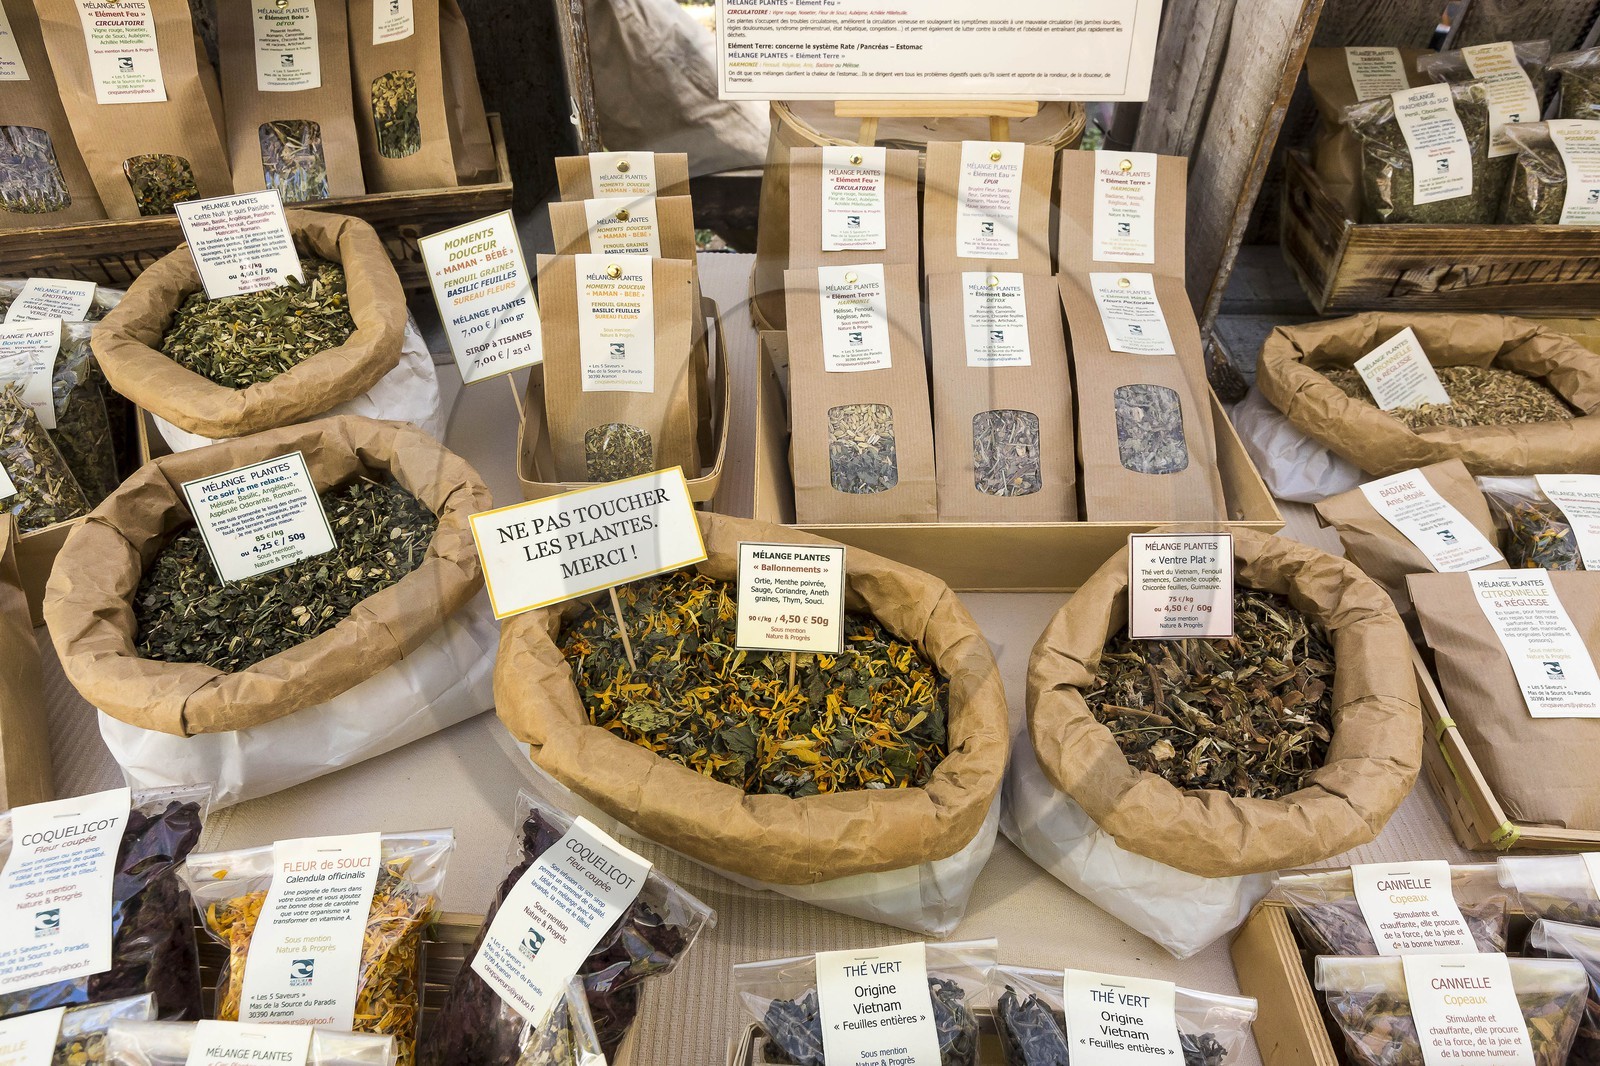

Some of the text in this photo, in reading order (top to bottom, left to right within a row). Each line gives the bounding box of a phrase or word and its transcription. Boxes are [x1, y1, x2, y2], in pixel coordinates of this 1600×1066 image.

[82, 1, 146, 10] MÉLANGE PLANTES
[754, 42, 774, 50] Terre:
[812, 43, 839, 51] système
[856, 43, 889, 51] /Pancréas
[201, 197, 259, 212] MÉLANGE PLANTES
[444, 227, 494, 251] MOMENTS
[449, 239, 497, 262] DOUCEUR
[443, 258, 478, 275] MAMAN
[485, 247, 508, 262] BÉBÉ
[443, 260, 515, 289] FENOUIL GRAINES
[447, 269, 517, 298] BASILIC FEUILLES
[825, 282, 880, 292] MÉLANGE PLANTES
[453, 280, 516, 306] SUREAU FLEURS
[452, 297, 526, 326] MÉLANGE PLANTES
[461, 324, 484, 338] 7,00
[500, 316, 515, 325] 100
[515, 312, 525, 322] gr
[465, 329, 533, 357] SIROP à TISANES
[473, 354, 497, 369] 7,00
[512, 347, 523, 355] 25
[523, 343, 531, 352] cl
[201, 462, 291, 494] MÉLANGE PLANTES
[207, 494, 219, 502] Ce
[219, 489, 235, 499] soir
[236, 486, 246, 495] je
[246, 483, 260, 491] me
[209, 481, 296, 510] Mélisse, Basilic, Angélique,
[1379, 480, 1416, 498] BADIANE
[209, 488, 301, 519] Aspérule Odorante, Romarin.
[1385, 489, 1426, 507] Anis étoilé
[496, 488, 670, 544] NE PAS TOUCHER
[252, 541, 273, 553] 4,25
[287, 532, 306, 542] 50g
[255, 534, 266, 542] 85
[522, 514, 658, 562] LES PLANTES.
[1145, 541, 1219, 551] MÉLANGE PLANTES
[560, 547, 628, 580] MERCI
[752, 550, 831, 562] MÉLANGE PLANTES
[1158, 556, 1188, 565] Ventre
[1190, 555, 1207, 564] Plat
[761, 563, 822, 574] Ballonnements
[750, 585, 830, 597] Sauge, Coriandre, Aneth
[754, 577, 827, 589] Ortie, Menthe poivrée,
[1477, 579, 1545, 588] MÉLANGE PLANTES
[754, 595, 825, 605] graines, Thym, Souci.
[1168, 595, 1178, 603] 75
[1480, 588, 1550, 599] CITRONNELLE
[1164, 604, 1182, 614] 4,50
[1196, 604, 1212, 613] 60g
[1503, 598, 1550, 607] RÉGLISSE
[779, 614, 801, 625] 4,50
[810, 616, 829, 626] 50g
[21, 817, 119, 847] COQUELICOT
[33, 834, 97, 855] Fleur coupée
[283, 856, 372, 873] FLEUR de SOUCI
[565, 838, 636, 890] COQUELICOT
[285, 870, 366, 884] Calendula officinalis
[565, 855, 612, 893] Fleur coupée
[1376, 878, 1432, 892] CANNELLE
[1389, 894, 1430, 906] Copeaux
[842, 960, 902, 978] THÉ VERT
[854, 983, 897, 999] Origine
[1431, 977, 1492, 990] CANNELLE
[1089, 989, 1151, 1008] THÉ VERT
[1443, 994, 1488, 1007] Copeaux
[852, 1001, 902, 1015] Vietnam
[842, 1018, 878, 1031] Feuilles
[880, 1014, 918, 1027] entières
[1100, 1010, 1144, 1026] Origine
[1099, 1024, 1150, 1041] Vietnam
[1088, 1037, 1125, 1051] Feuilles
[1126, 1043, 1166, 1056] entières
